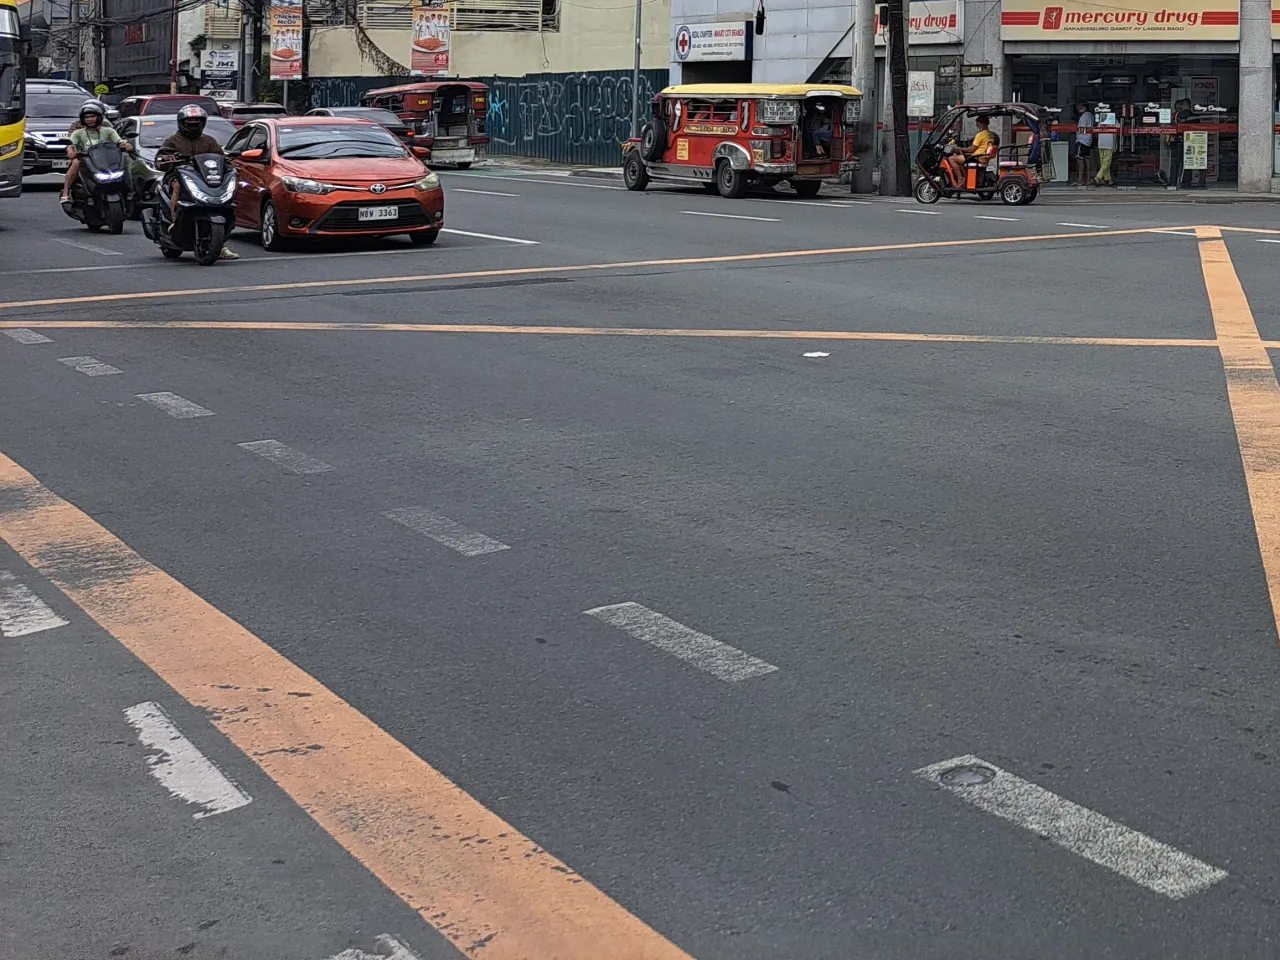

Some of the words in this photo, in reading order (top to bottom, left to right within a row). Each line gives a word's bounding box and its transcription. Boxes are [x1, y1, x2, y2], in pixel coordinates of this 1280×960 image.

[924, 13, 948, 30] drug
[1064, 11, 1148, 26] mercury
[1154, 9, 1199, 26] drug
[378, 209, 398, 217] 3363
